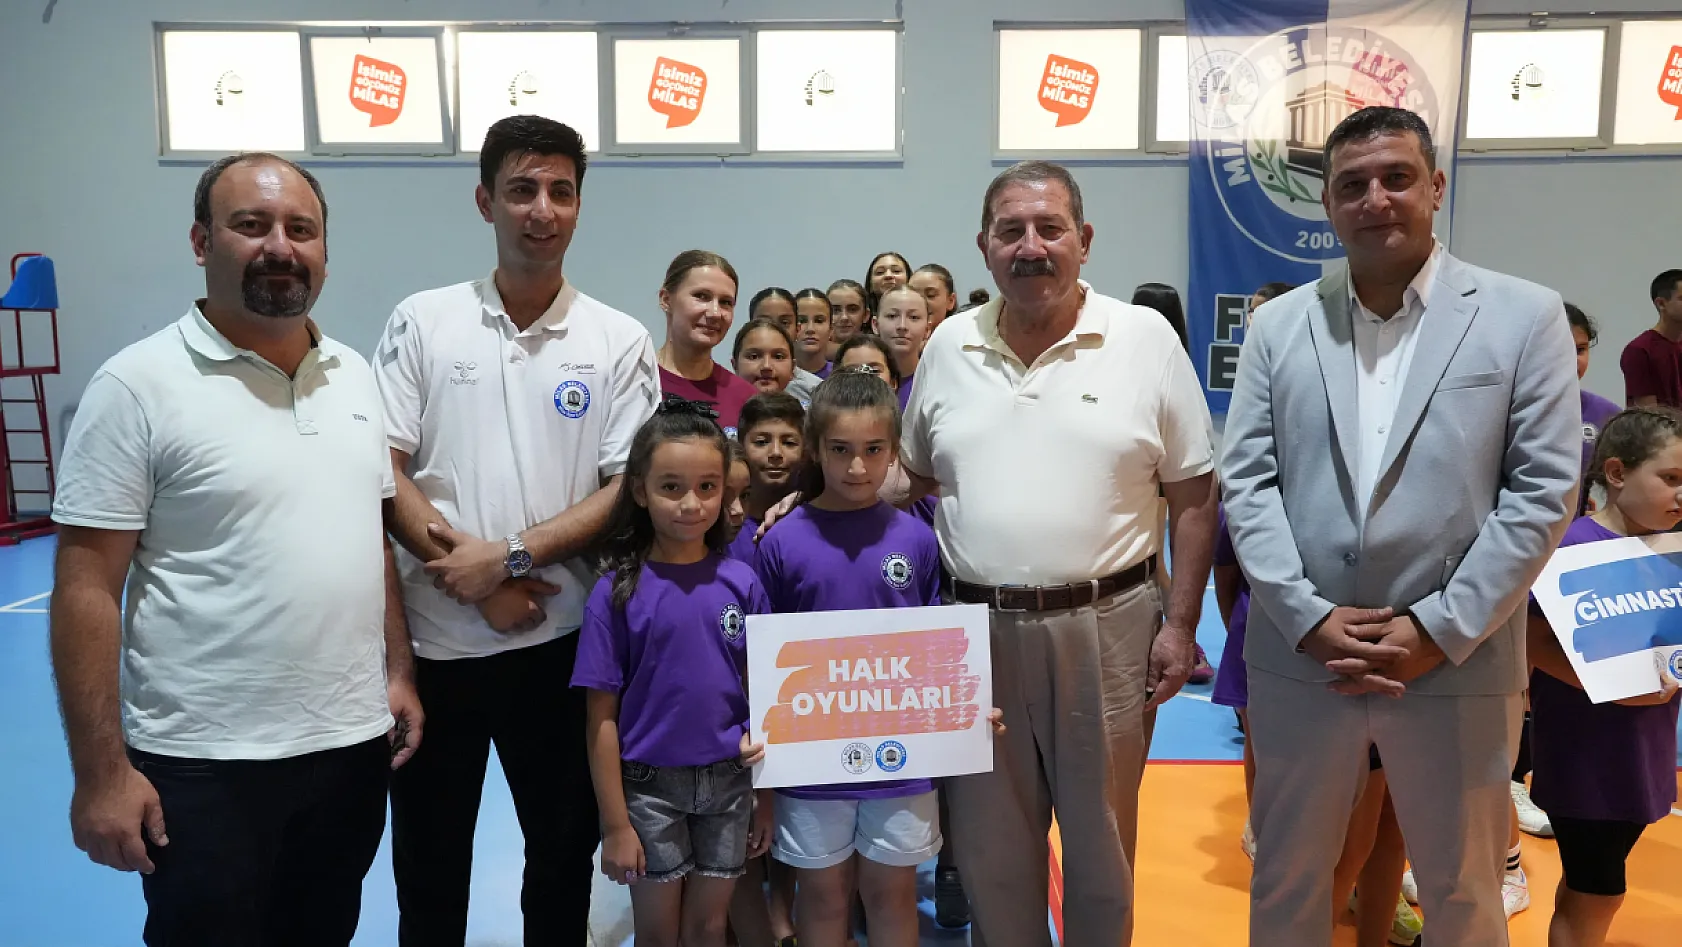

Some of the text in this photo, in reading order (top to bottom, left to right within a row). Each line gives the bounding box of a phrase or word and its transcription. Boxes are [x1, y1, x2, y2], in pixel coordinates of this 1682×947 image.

[353, 86, 399, 109] MİLAS
[651, 87, 698, 110] MİLAS
[1042, 86, 1089, 109] MİLAS
[1214, 293, 1252, 342] F
[828, 656, 912, 683] HALK
[792, 685, 951, 716] OYUNLARI
